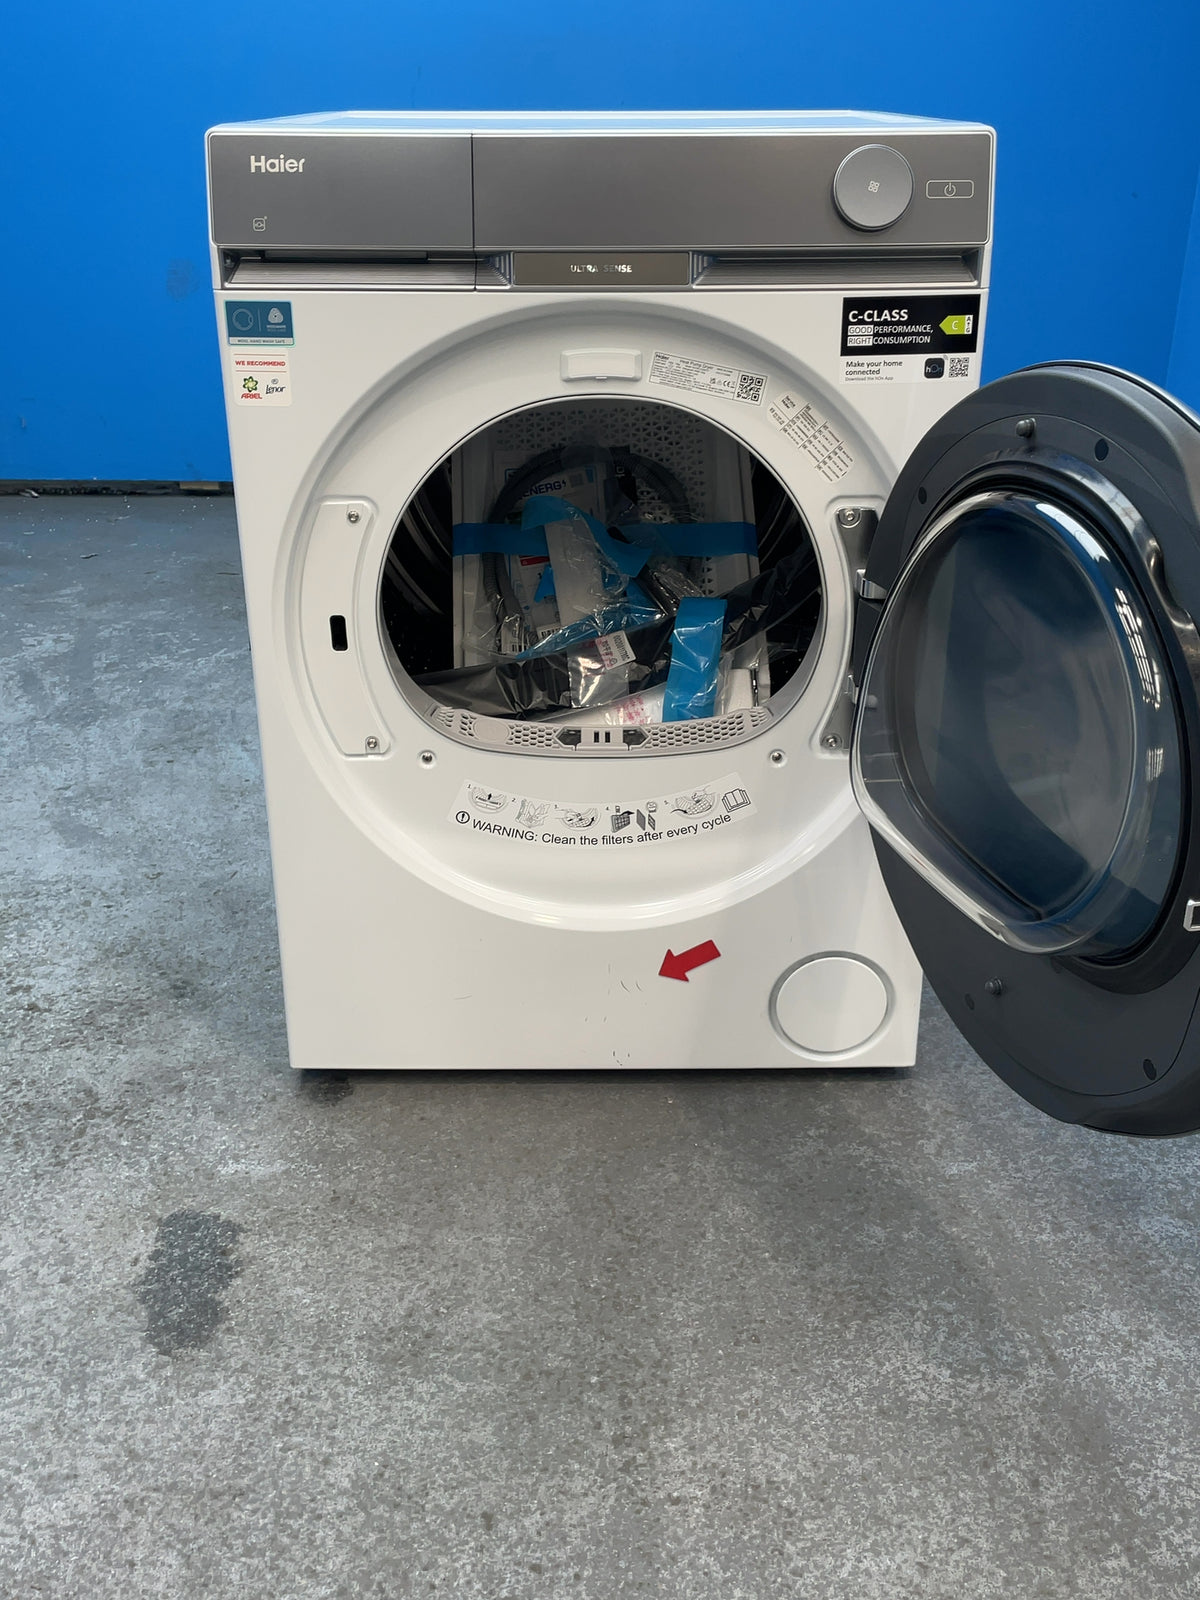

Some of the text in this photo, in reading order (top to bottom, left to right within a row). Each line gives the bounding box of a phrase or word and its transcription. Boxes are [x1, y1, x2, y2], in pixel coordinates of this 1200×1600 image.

[250, 154, 305, 172] Haier
[570, 264, 633, 273] ULTRA SENSE
[848, 309, 908, 322] C-CLASS
[849, 324, 934, 334] GOOD PERFORMANCE,
[952, 320, 958, 330] C
[848, 336, 931, 345] RIGHT CONSUMPTION
[266, 384, 286, 394] Lenor
[472, 814, 732, 845] WARNING: Clean the filters after every cycle
